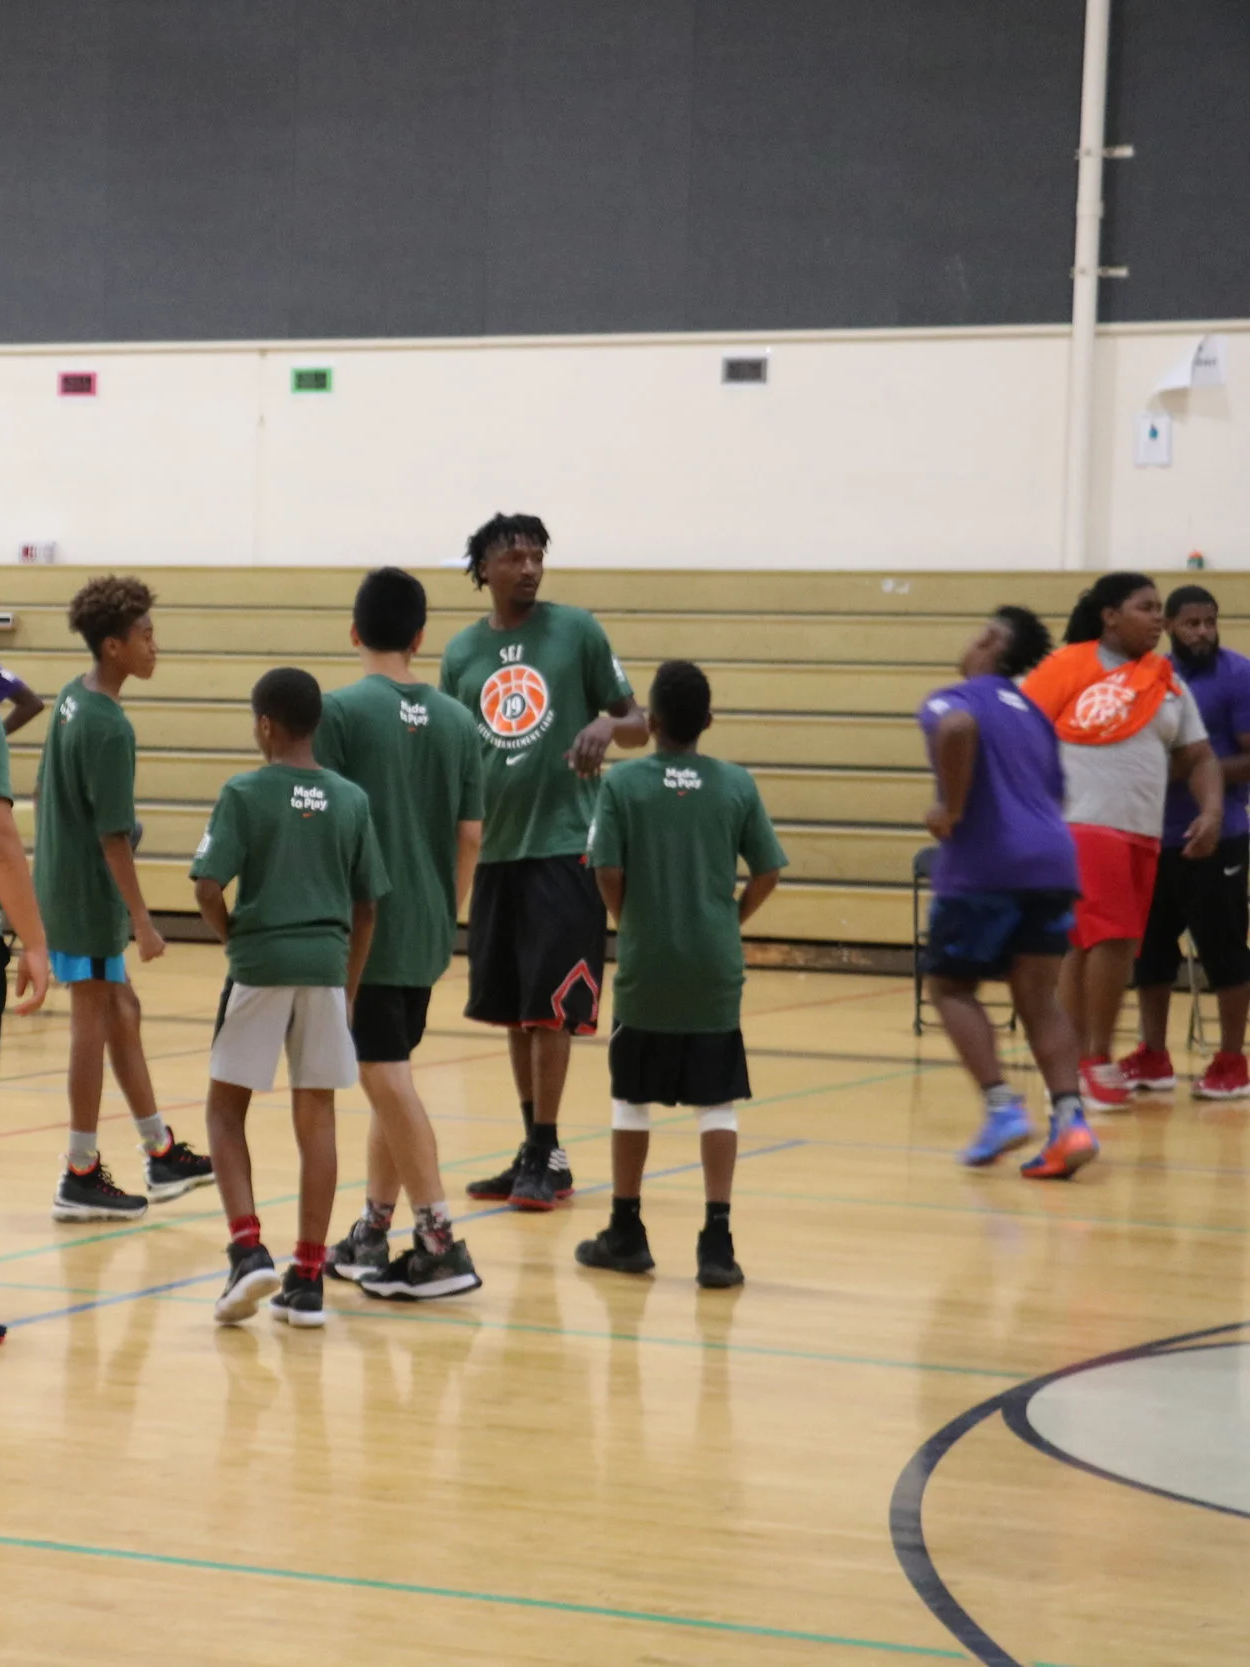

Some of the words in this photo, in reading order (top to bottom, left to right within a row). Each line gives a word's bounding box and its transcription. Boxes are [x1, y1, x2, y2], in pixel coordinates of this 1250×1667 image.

[505, 695, 523, 717] 19
[293, 785, 325, 799] Made
[290, 796, 303, 809] to
[304, 798, 328, 811] Play
